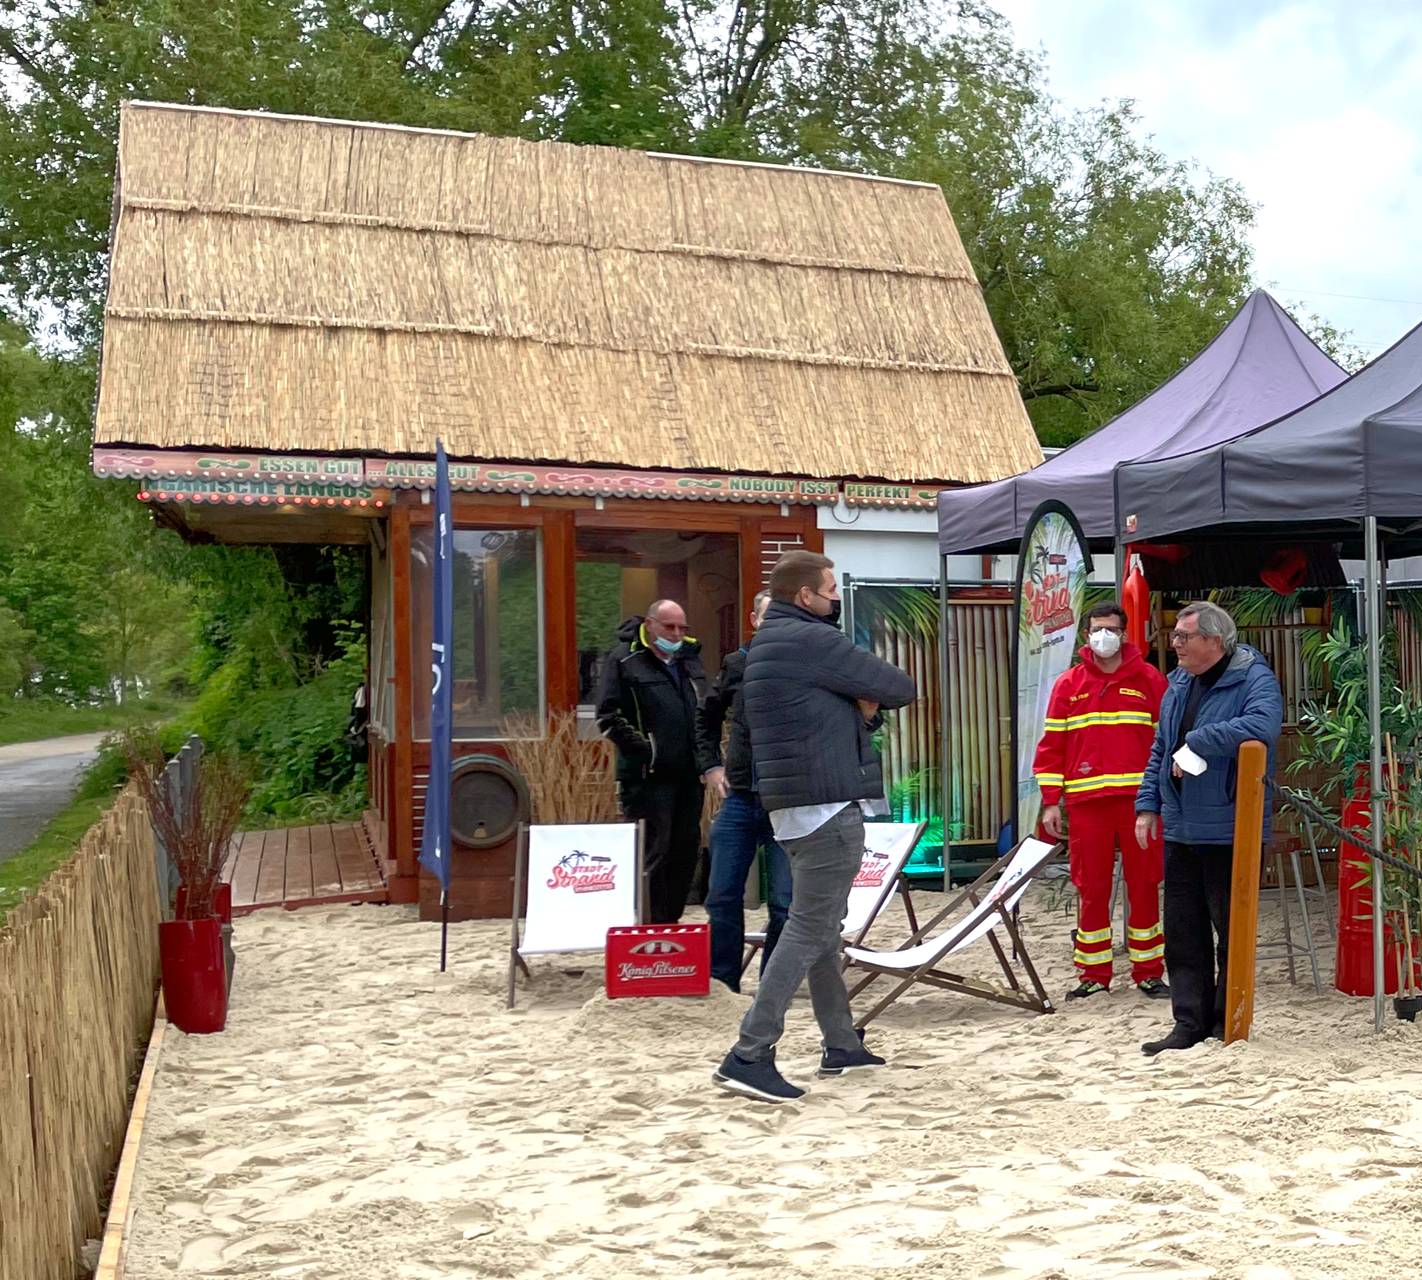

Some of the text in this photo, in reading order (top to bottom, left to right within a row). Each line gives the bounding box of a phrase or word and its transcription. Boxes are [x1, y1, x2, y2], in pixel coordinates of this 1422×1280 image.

[258, 458, 320, 474] ESSEN
[323, 460, 362, 475] GUT
[385, 461, 437, 478] ALLES
[729, 477, 912, 499] NOBODY ISST PERFEKT
[652, 961, 697, 977] Pilsener
